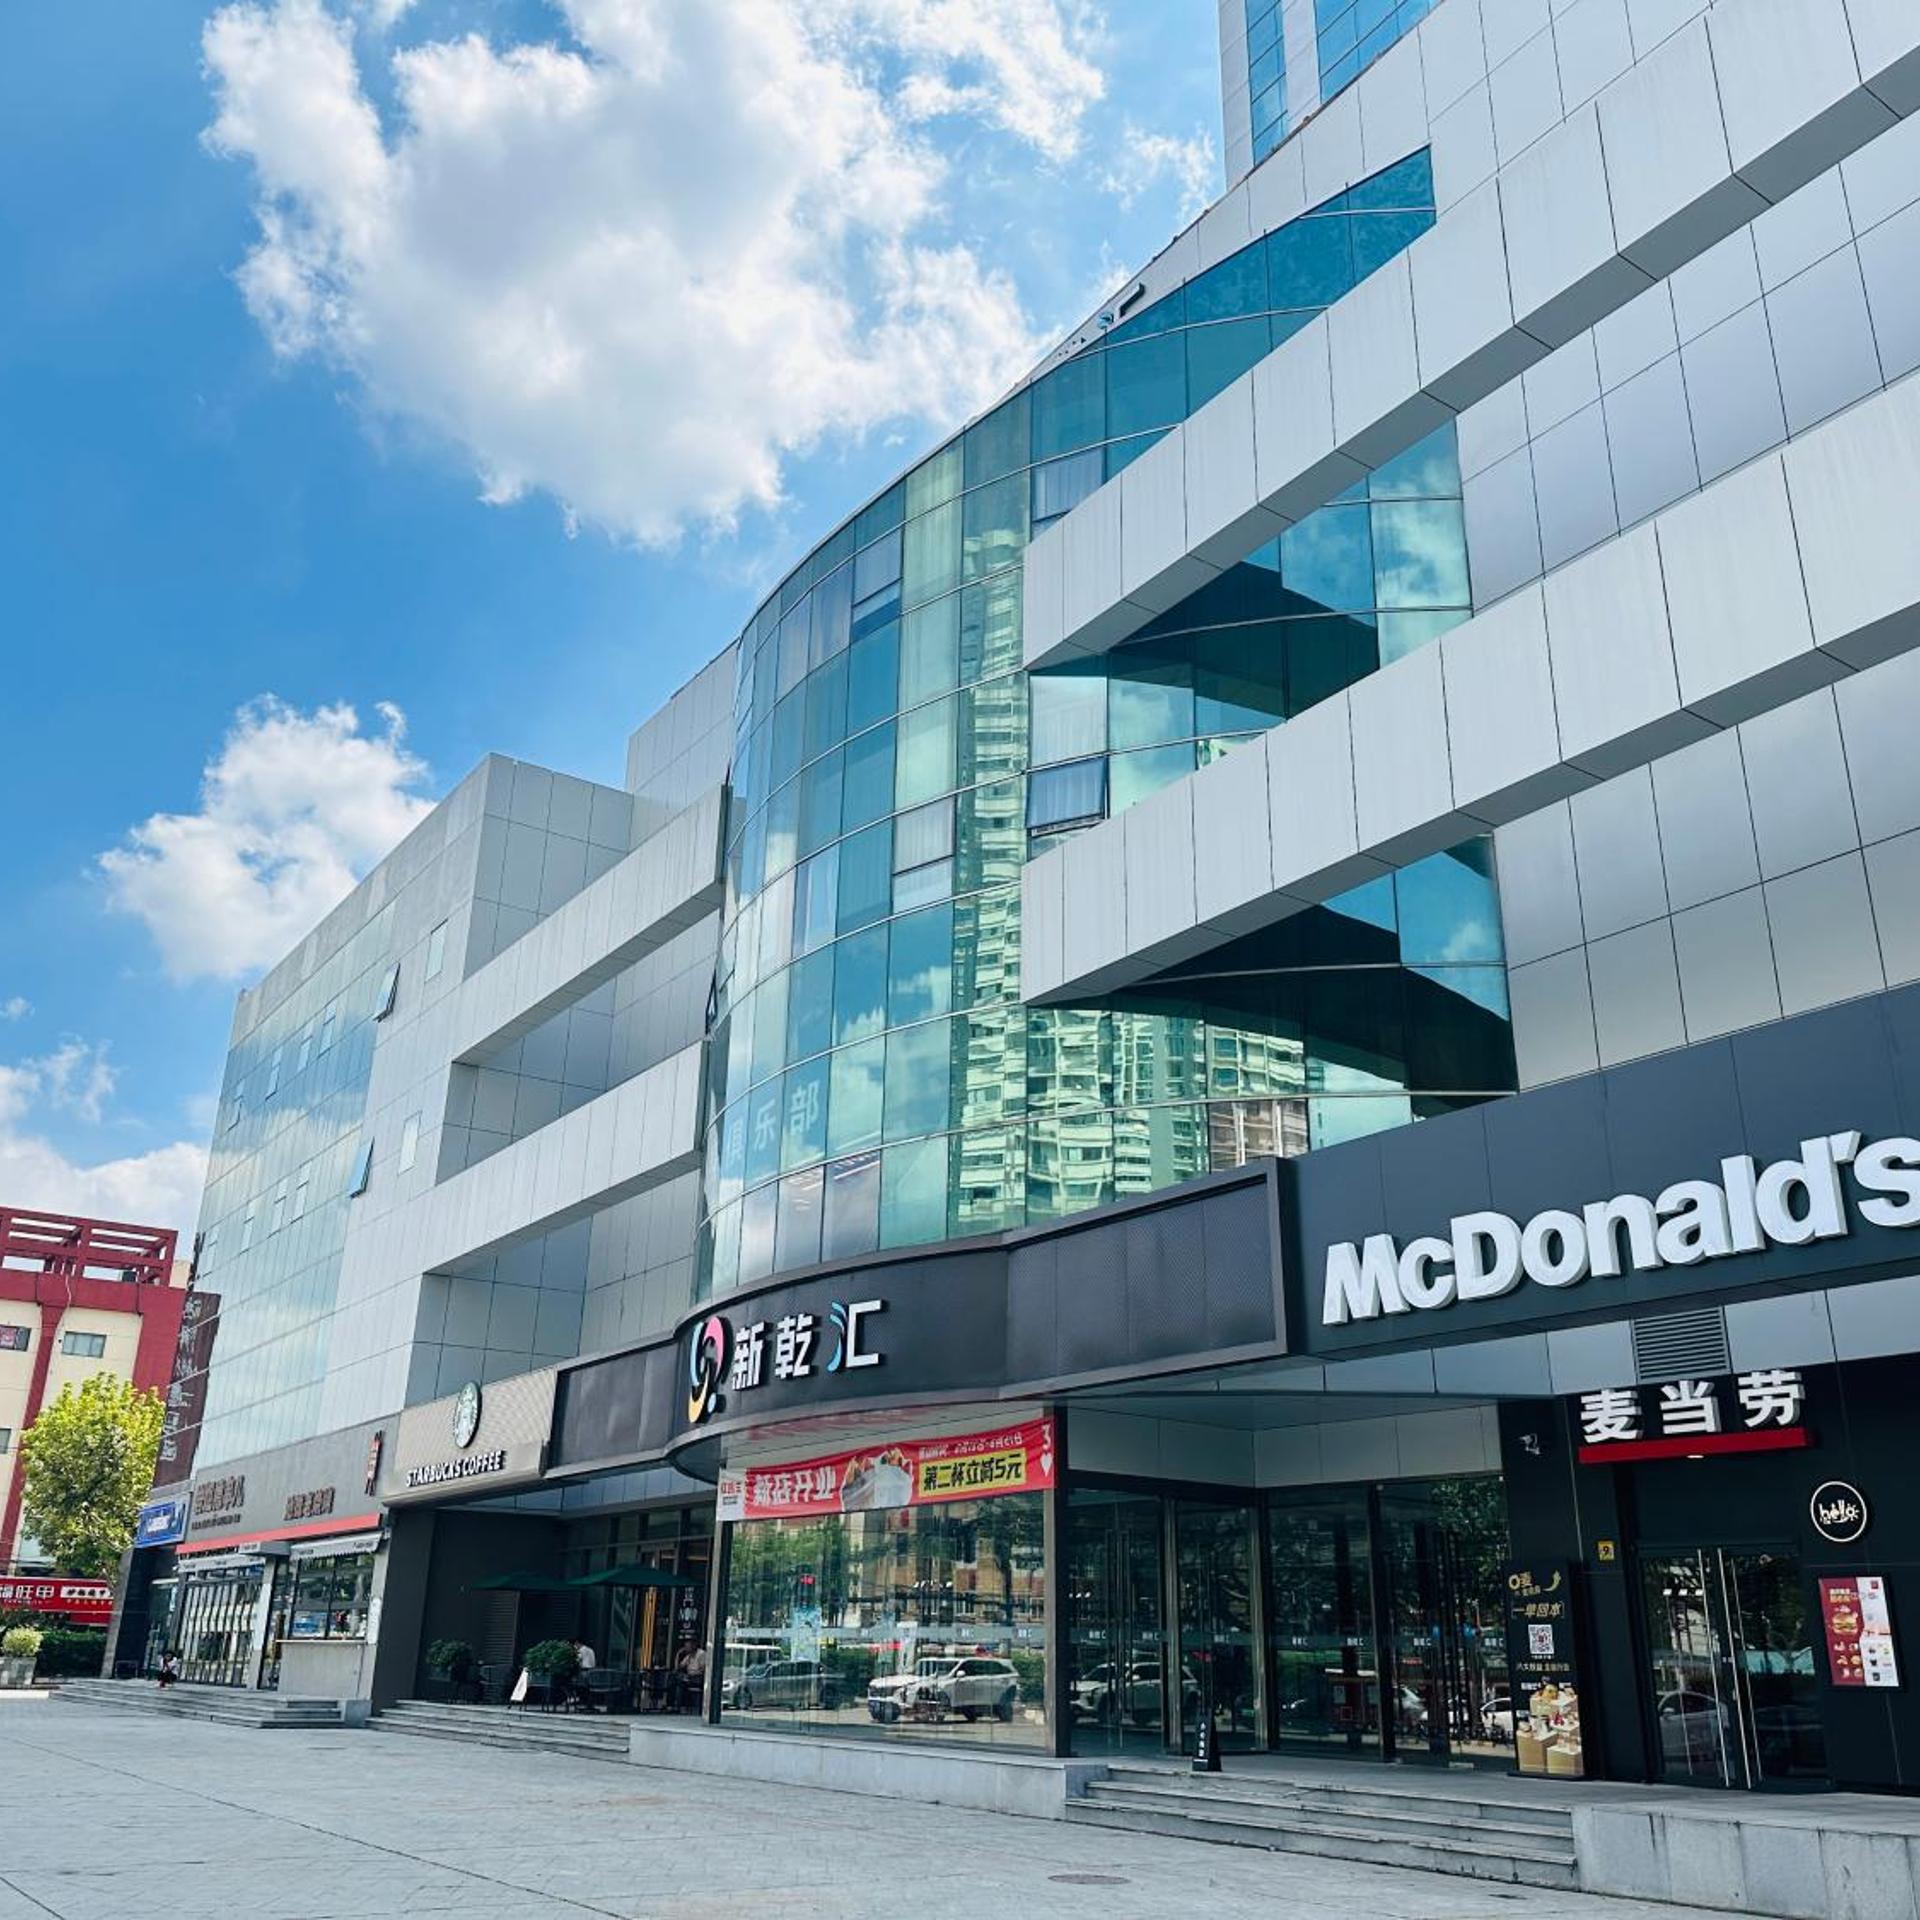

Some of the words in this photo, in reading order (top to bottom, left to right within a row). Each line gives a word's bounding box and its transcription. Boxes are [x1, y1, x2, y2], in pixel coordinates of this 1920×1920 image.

[1322, 1130, 1920, 1325] McDonald's
[731, 1299, 882, 1390] 新乾汇
[1580, 1369, 1805, 1444] 麦当劳
[405, 1459, 462, 1488] STARBUCKS
[462, 1450, 504, 1478] COFFEE
[753, 1465, 837, 1507] 新店开业
[923, 1453, 1022, 1492] 第二杯立减5元
